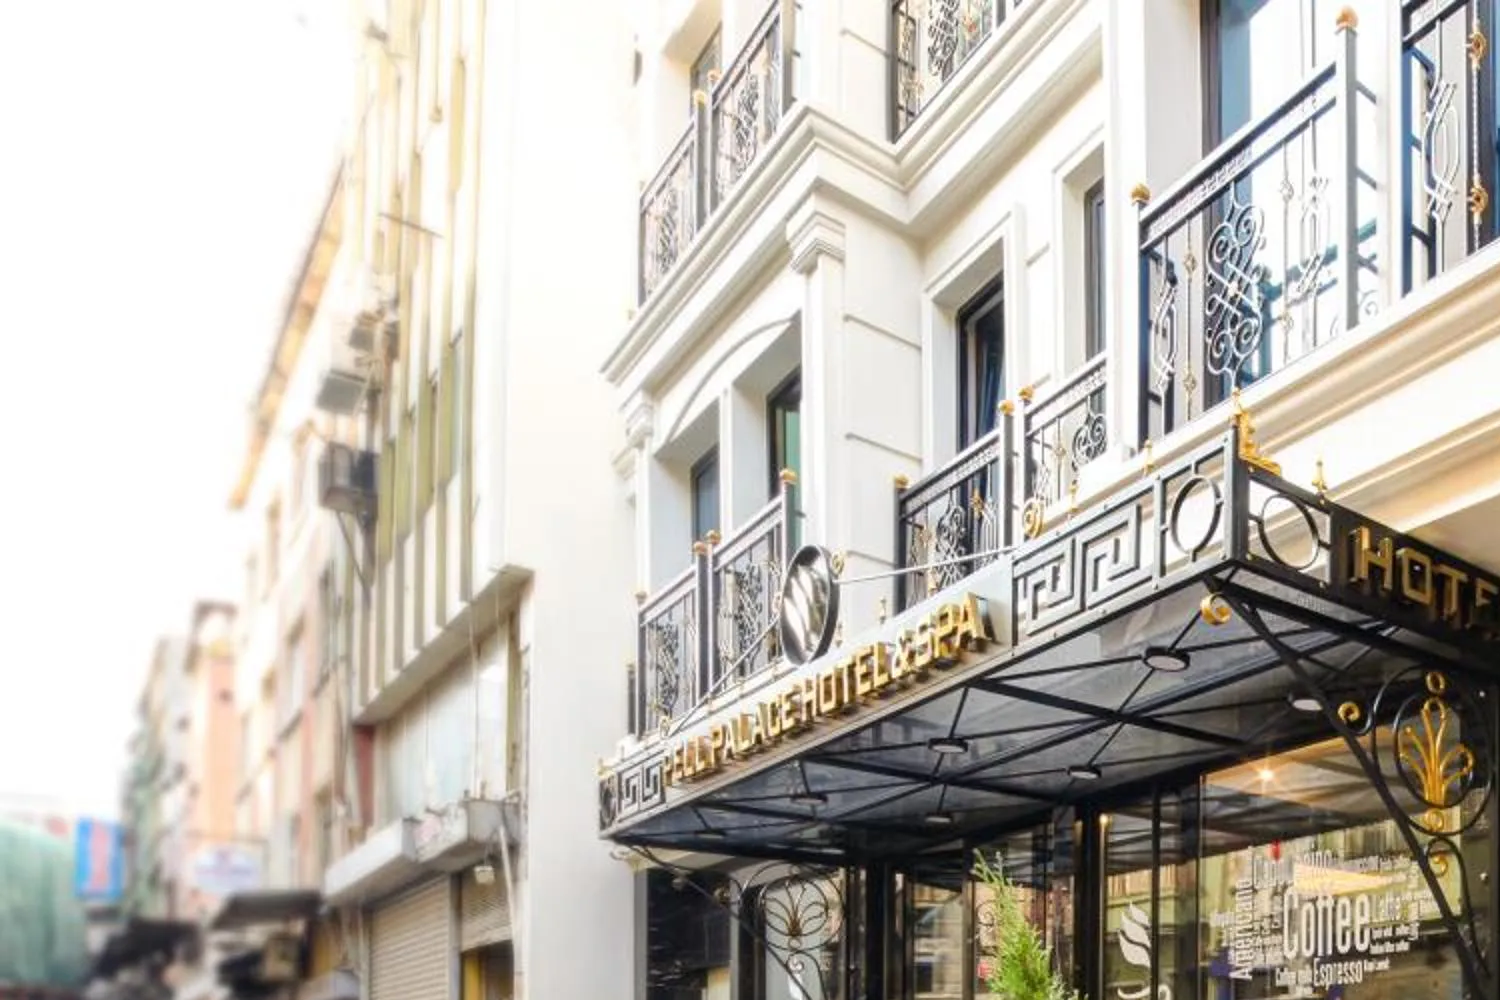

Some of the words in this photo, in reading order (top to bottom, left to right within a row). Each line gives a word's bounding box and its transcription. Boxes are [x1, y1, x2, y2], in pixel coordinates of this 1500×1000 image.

[710, 689, 797, 768] PALACE
[800, 640, 889, 724] HOTEL
[1283, 885, 1370, 960] Coffee
